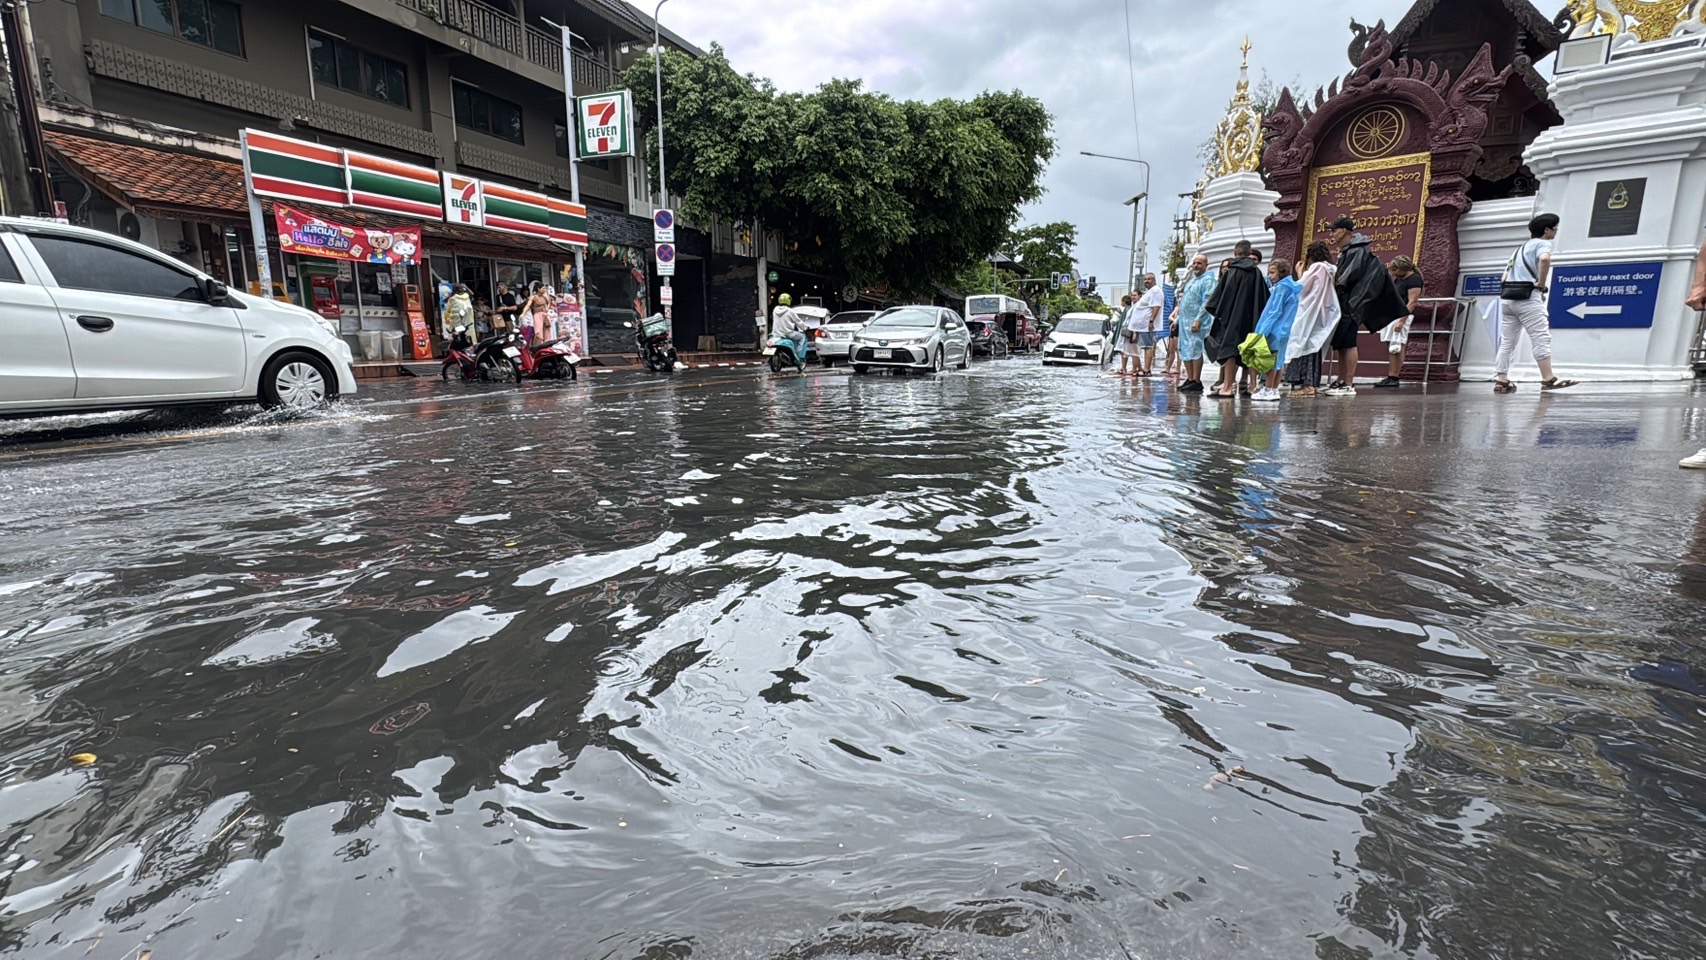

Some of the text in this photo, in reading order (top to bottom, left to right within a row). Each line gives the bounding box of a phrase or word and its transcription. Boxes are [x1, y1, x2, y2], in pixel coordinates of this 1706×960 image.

[588, 101, 616, 152] 7
[451, 177, 476, 222] 7
[294, 231, 324, 245] Hello
[1558, 275, 1586, 283] Tourist
[1588, 274, 1608, 282] take
[1610, 273, 1630, 281] next
